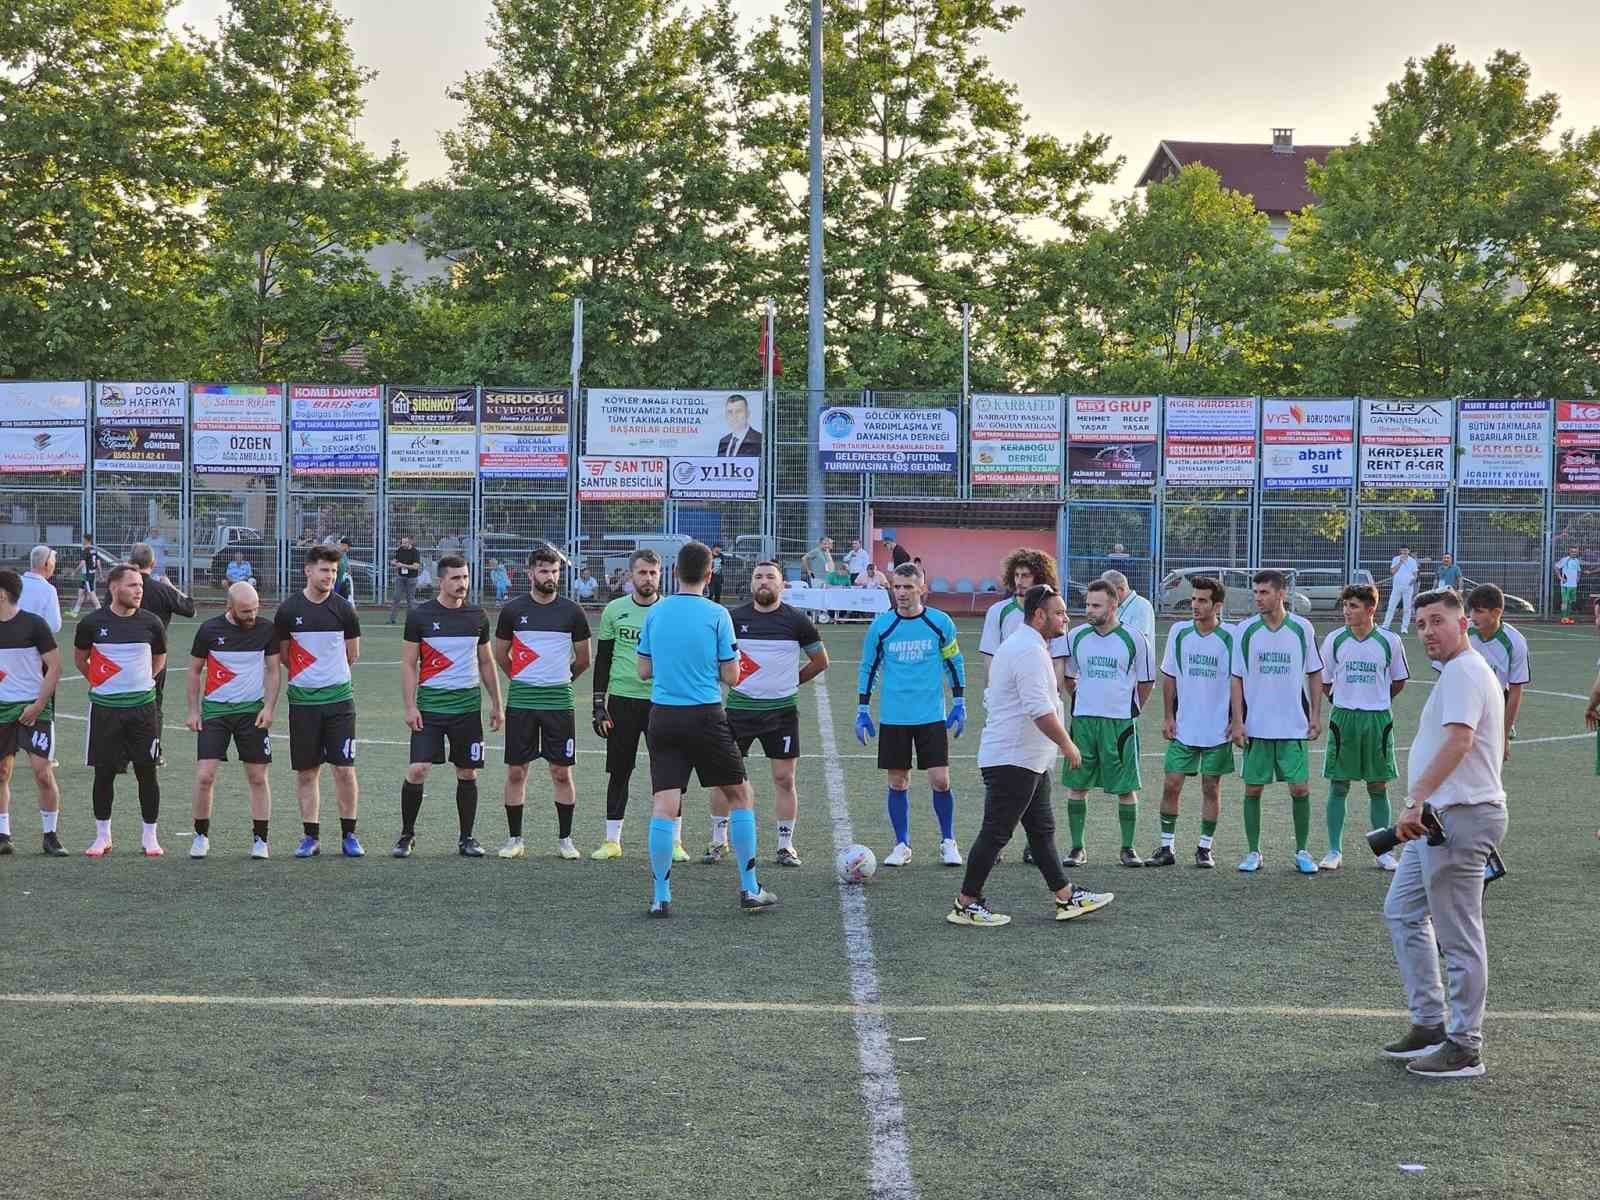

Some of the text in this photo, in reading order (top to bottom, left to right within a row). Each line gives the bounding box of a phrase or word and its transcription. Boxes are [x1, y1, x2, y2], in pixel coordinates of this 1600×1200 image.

[412, 396, 455, 414] ŞİRİNKÖY
[604, 395, 639, 404] KÖYLER
[672, 398, 705, 406] FUTBOL
[1108, 400, 1152, 412] GRUP
[670, 407, 709, 415] KATILAN
[907, 453, 940, 461] FUTBOL
[1298, 448, 1343, 460] abant
[1368, 447, 1444, 460] KARDEŞLER
[614, 460, 664, 472] SAN TUR
[890, 463, 909, 472] HOŞ
[1312, 464, 1328, 473] su
[1367, 460, 1445, 471] RENT A-CAR
[580, 477, 618, 487] SANTUR
[264, 736, 271, 755] 3
